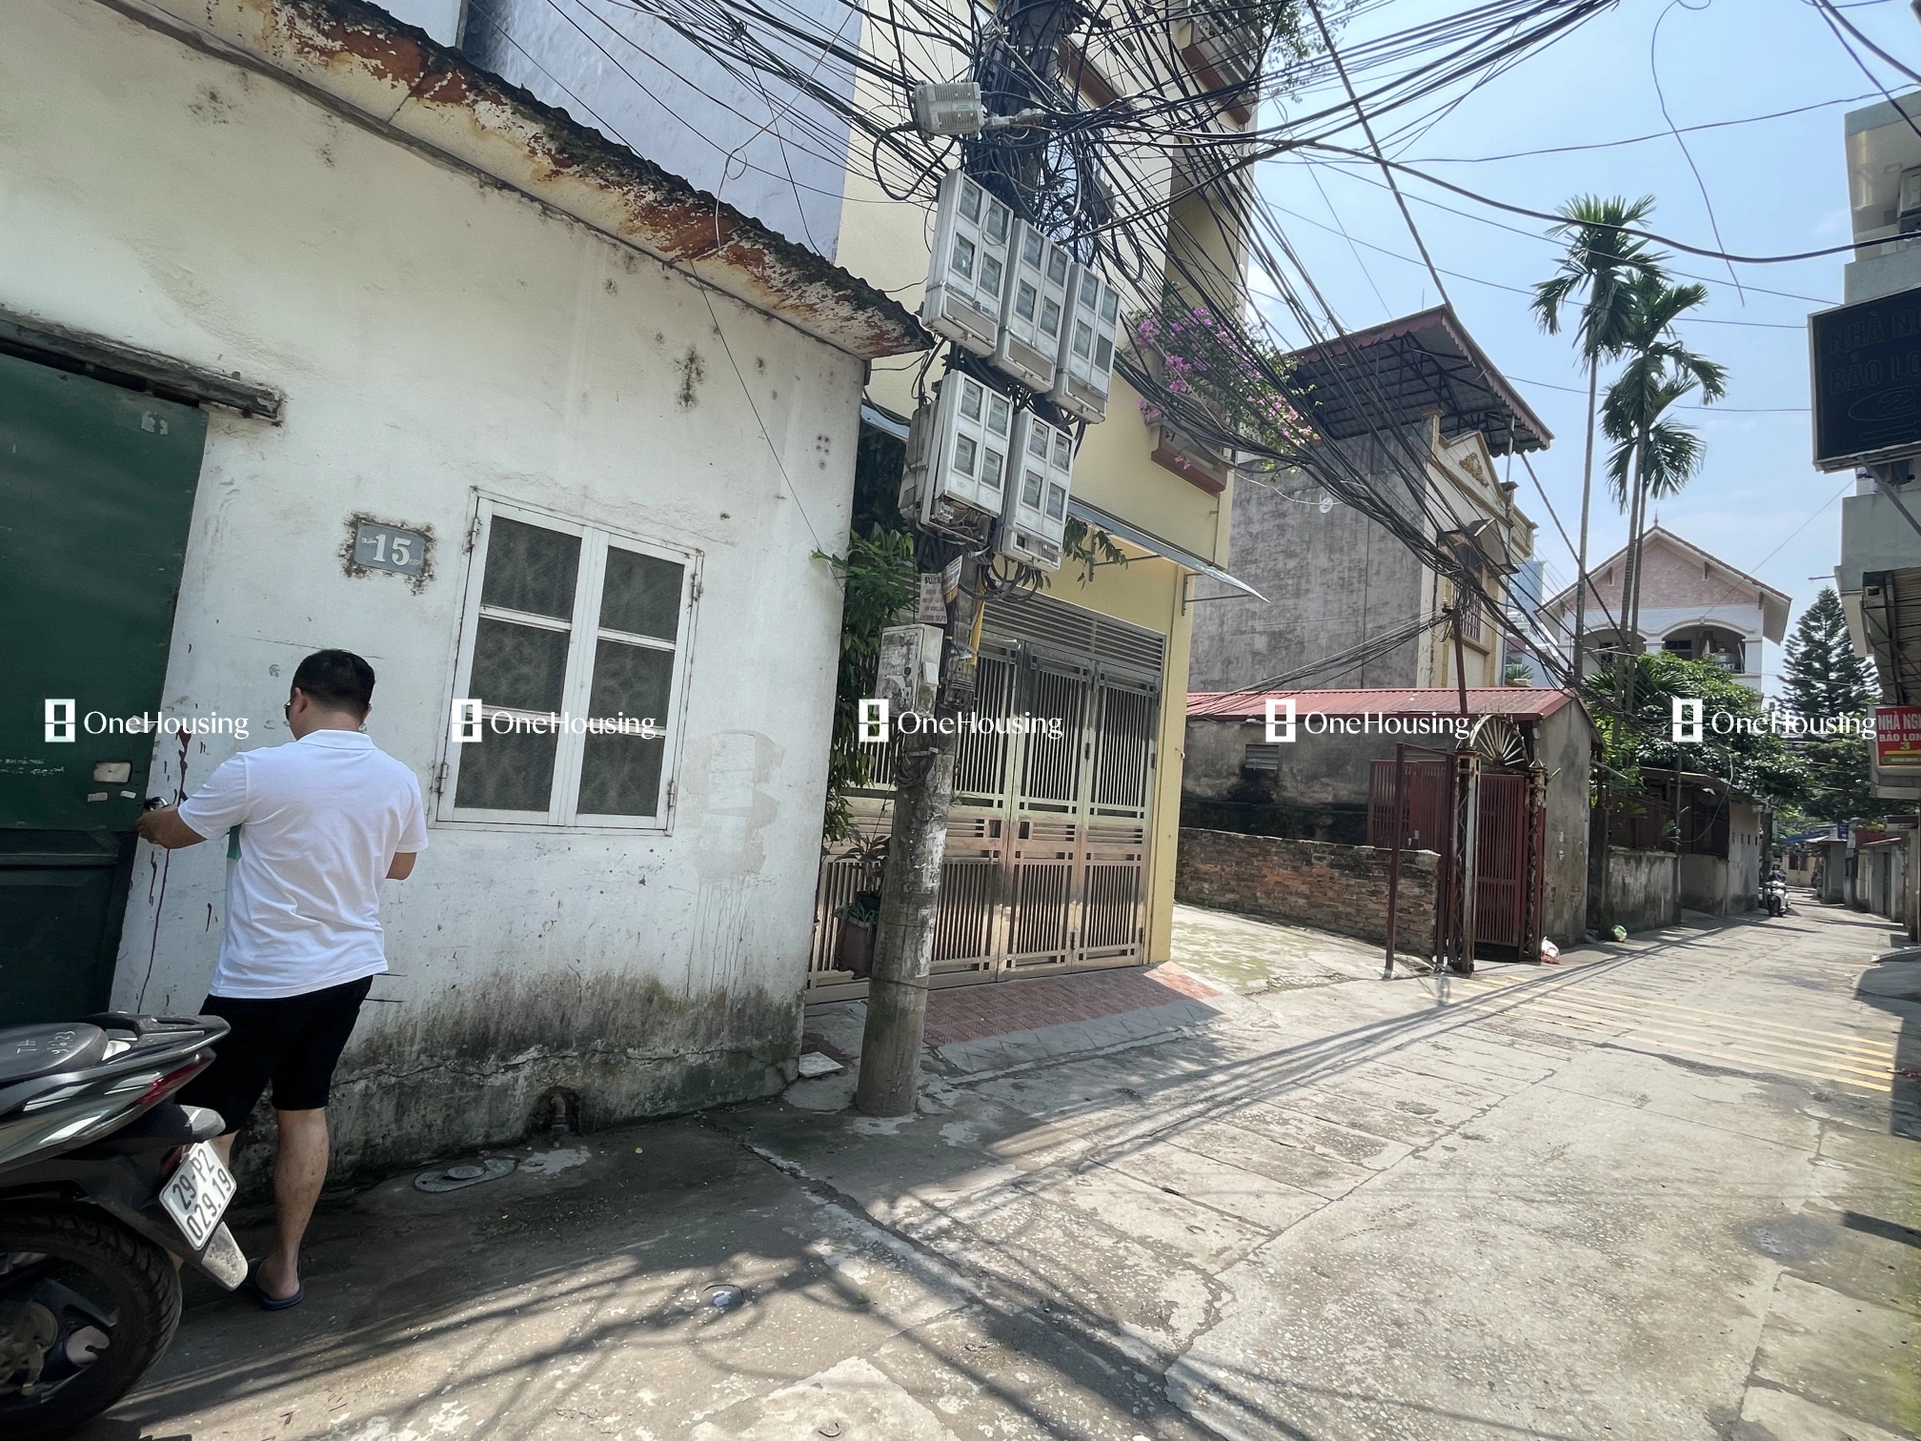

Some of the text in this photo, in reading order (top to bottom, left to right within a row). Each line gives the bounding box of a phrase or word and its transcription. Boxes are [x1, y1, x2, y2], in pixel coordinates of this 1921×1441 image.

[1828, 311, 1885, 355] NHÀ
[372, 533, 412, 566] 15
[1877, 711, 1900, 730] NHÀ
[1900, 742, 1911, 750] 3
[172, 1148, 215, 1211] 29-P2
[186, 1167, 232, 1240] 029.19
